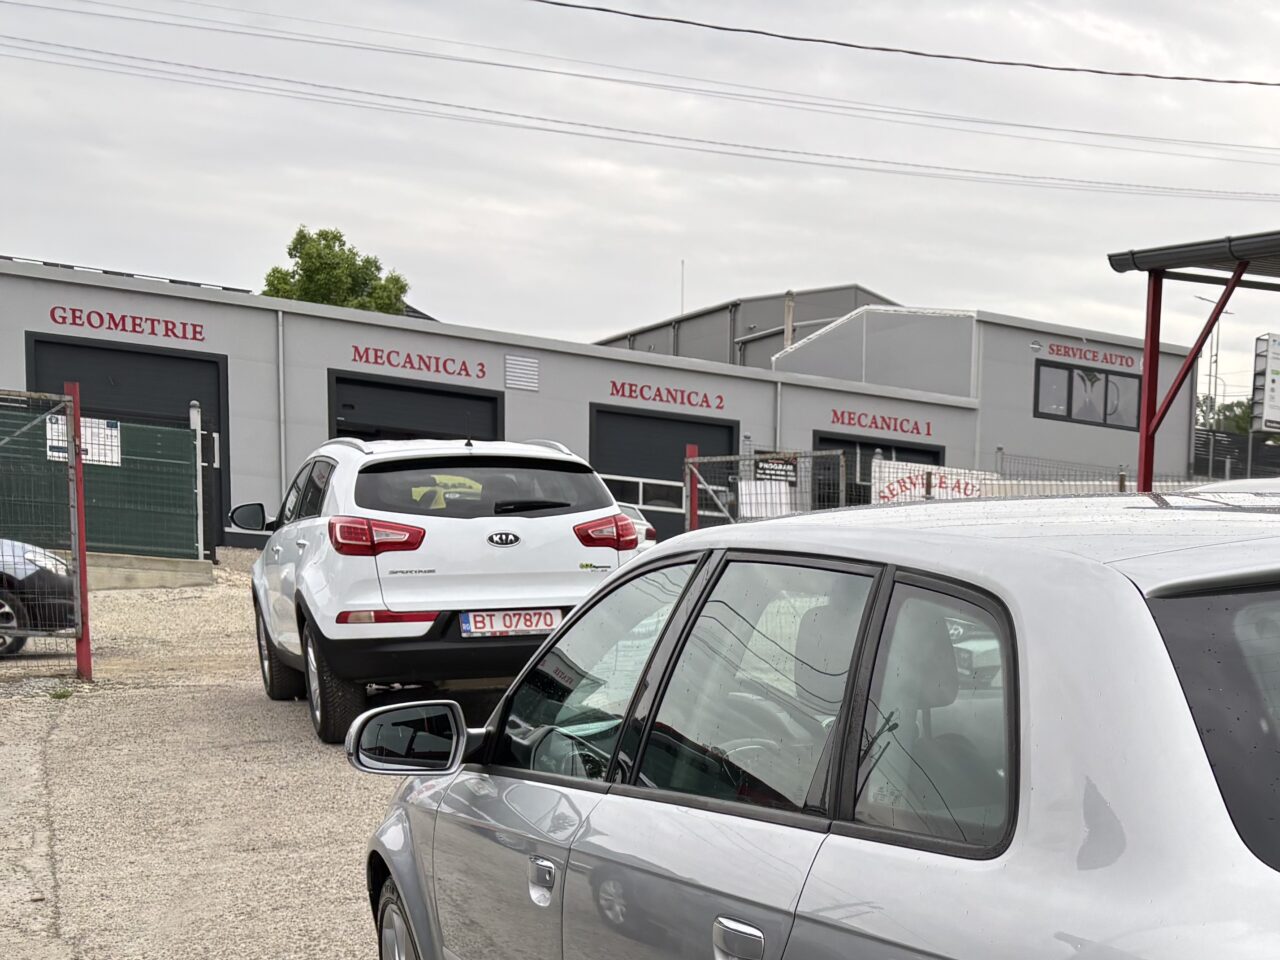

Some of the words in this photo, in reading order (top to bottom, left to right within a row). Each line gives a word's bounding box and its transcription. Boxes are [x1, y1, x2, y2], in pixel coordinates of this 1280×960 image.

[50, 306, 205, 342] GEOMETRIE
[352, 345, 472, 377] MECANICA
[476, 362, 486, 379] 3
[1048, 343, 1099, 362] SERVICE
[1101, 352, 1134, 368] AUTO
[610, 380, 712, 409] MECANICA
[715, 394, 725, 410] 2
[831, 409, 921, 435] MECANICA
[924, 421, 933, 436] 1
[493, 534, 516, 544] KIA
[473, 613, 495, 630] BT
[502, 611, 554, 629] 07870
